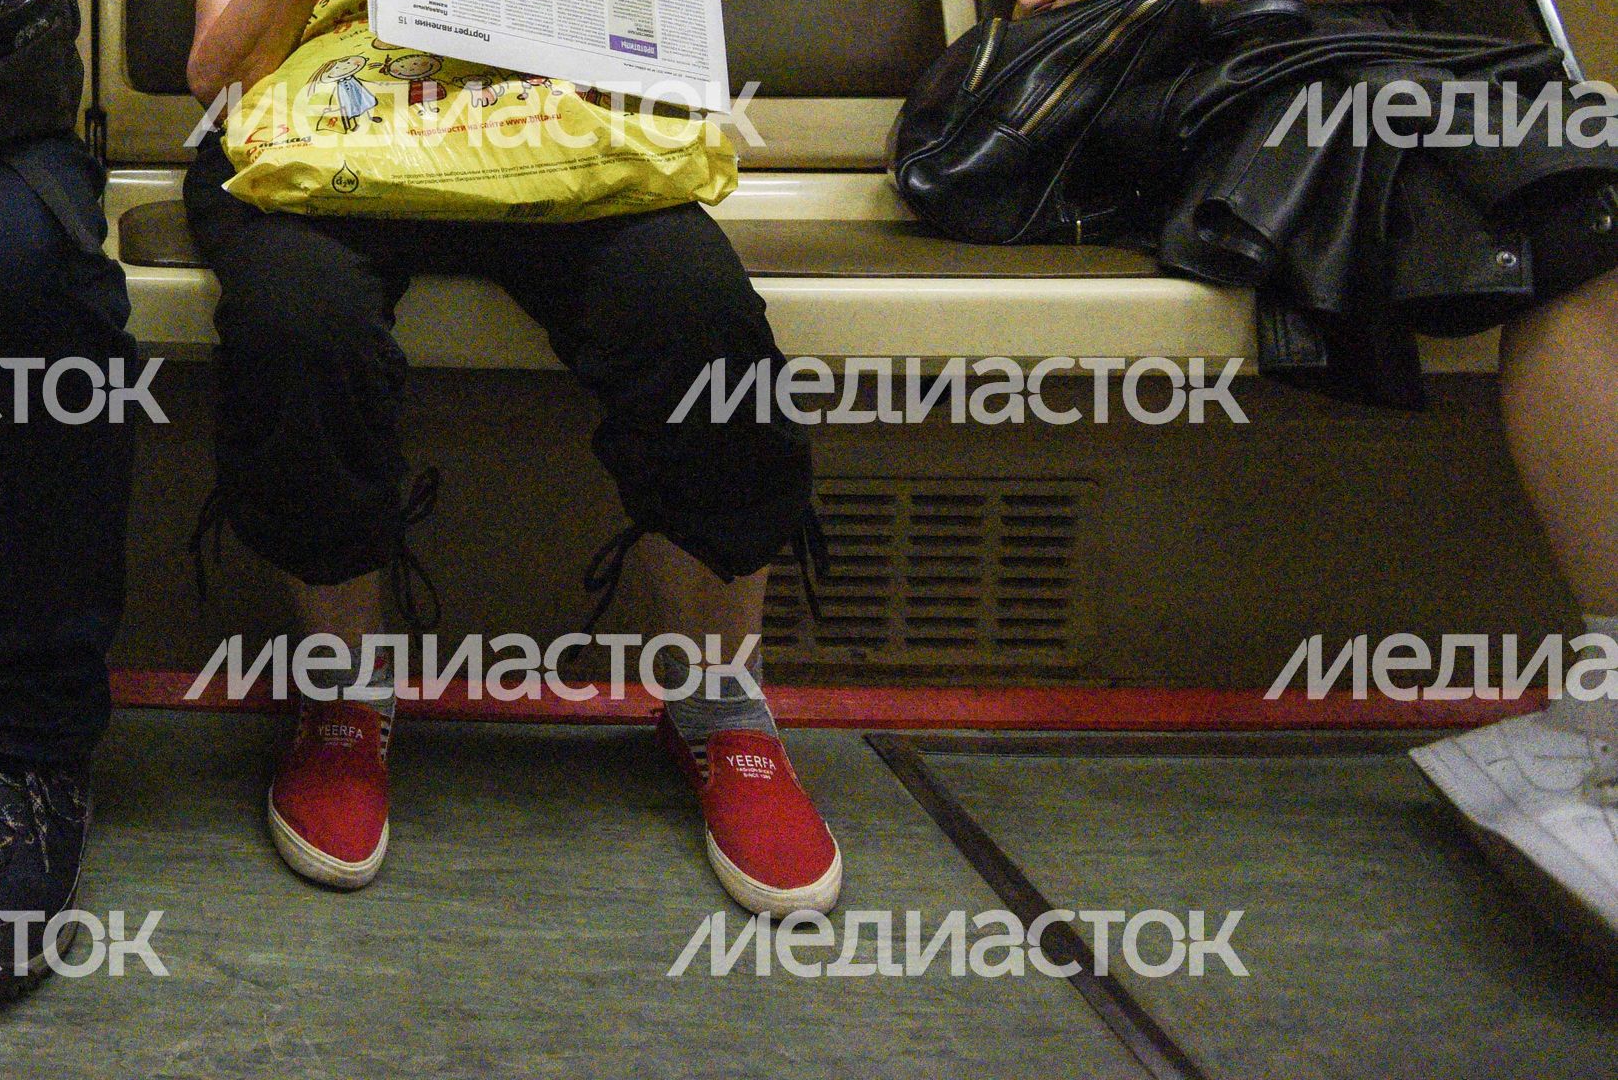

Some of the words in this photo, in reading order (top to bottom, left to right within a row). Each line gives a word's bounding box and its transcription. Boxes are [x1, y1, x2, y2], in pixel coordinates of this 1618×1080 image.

[398, 15, 408, 25] 15
[414, 18, 452, 32] явления
[454, 27, 490, 42] Портрет
[725, 754, 777, 770] YEERFA
